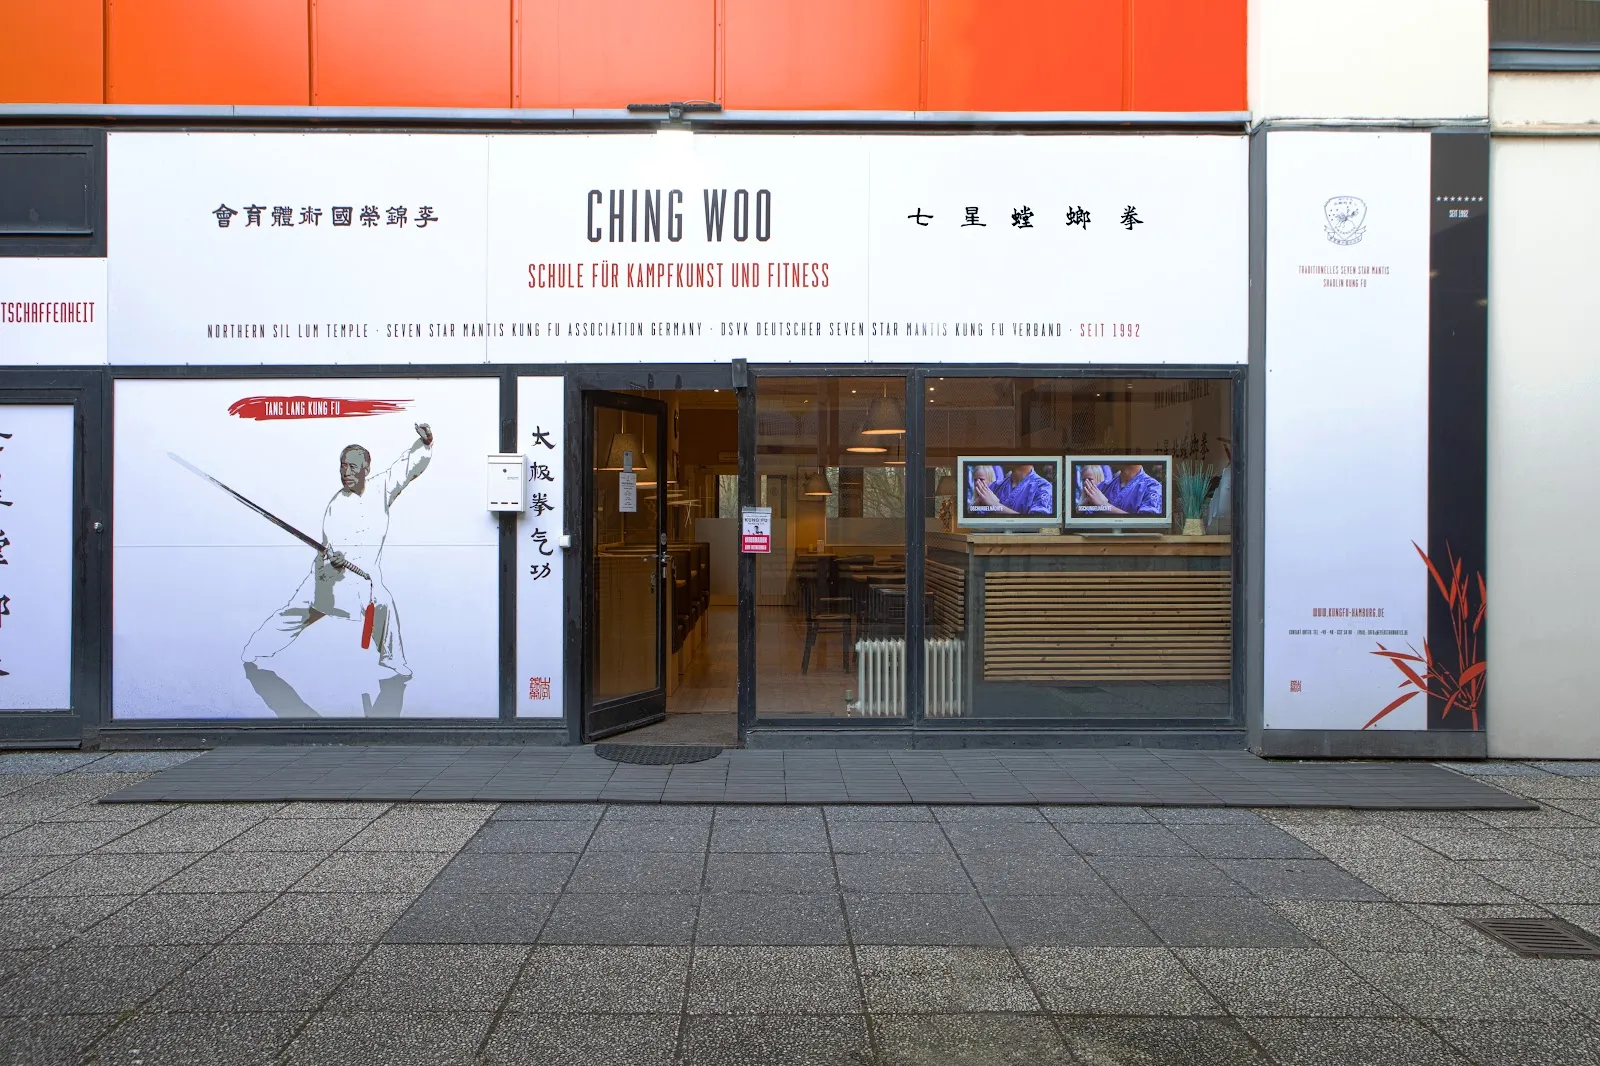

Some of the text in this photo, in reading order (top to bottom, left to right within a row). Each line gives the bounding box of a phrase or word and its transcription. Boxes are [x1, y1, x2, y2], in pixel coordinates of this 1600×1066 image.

[587, 189, 772, 242] CHING WOO
[907, 205, 1144, 230] 七星螳螂拳
[528, 259, 829, 289] SCHULE FÜR KAMPFKUNST UND FITNESS
[1299, 266, 1390, 275] TRADITIONELLES SEVEN STAR MANTIS
[1323, 279, 1367, 288] SHAOLIN KUNG FU
[1, 302, 95, 323] TSCHAFFENHEIT
[207, 322, 1140, 338] NORTHERN SIL LUM TEMPLE SEVEN STAR MANTIS KUNG FU ASSOCIATION GERMANY DSVK DEUTSCHER SEVEN STAR MANTIS KUNG FU VERBAND SEIT 1992
[265, 401, 341, 416] TANG LANG KUNG FU
